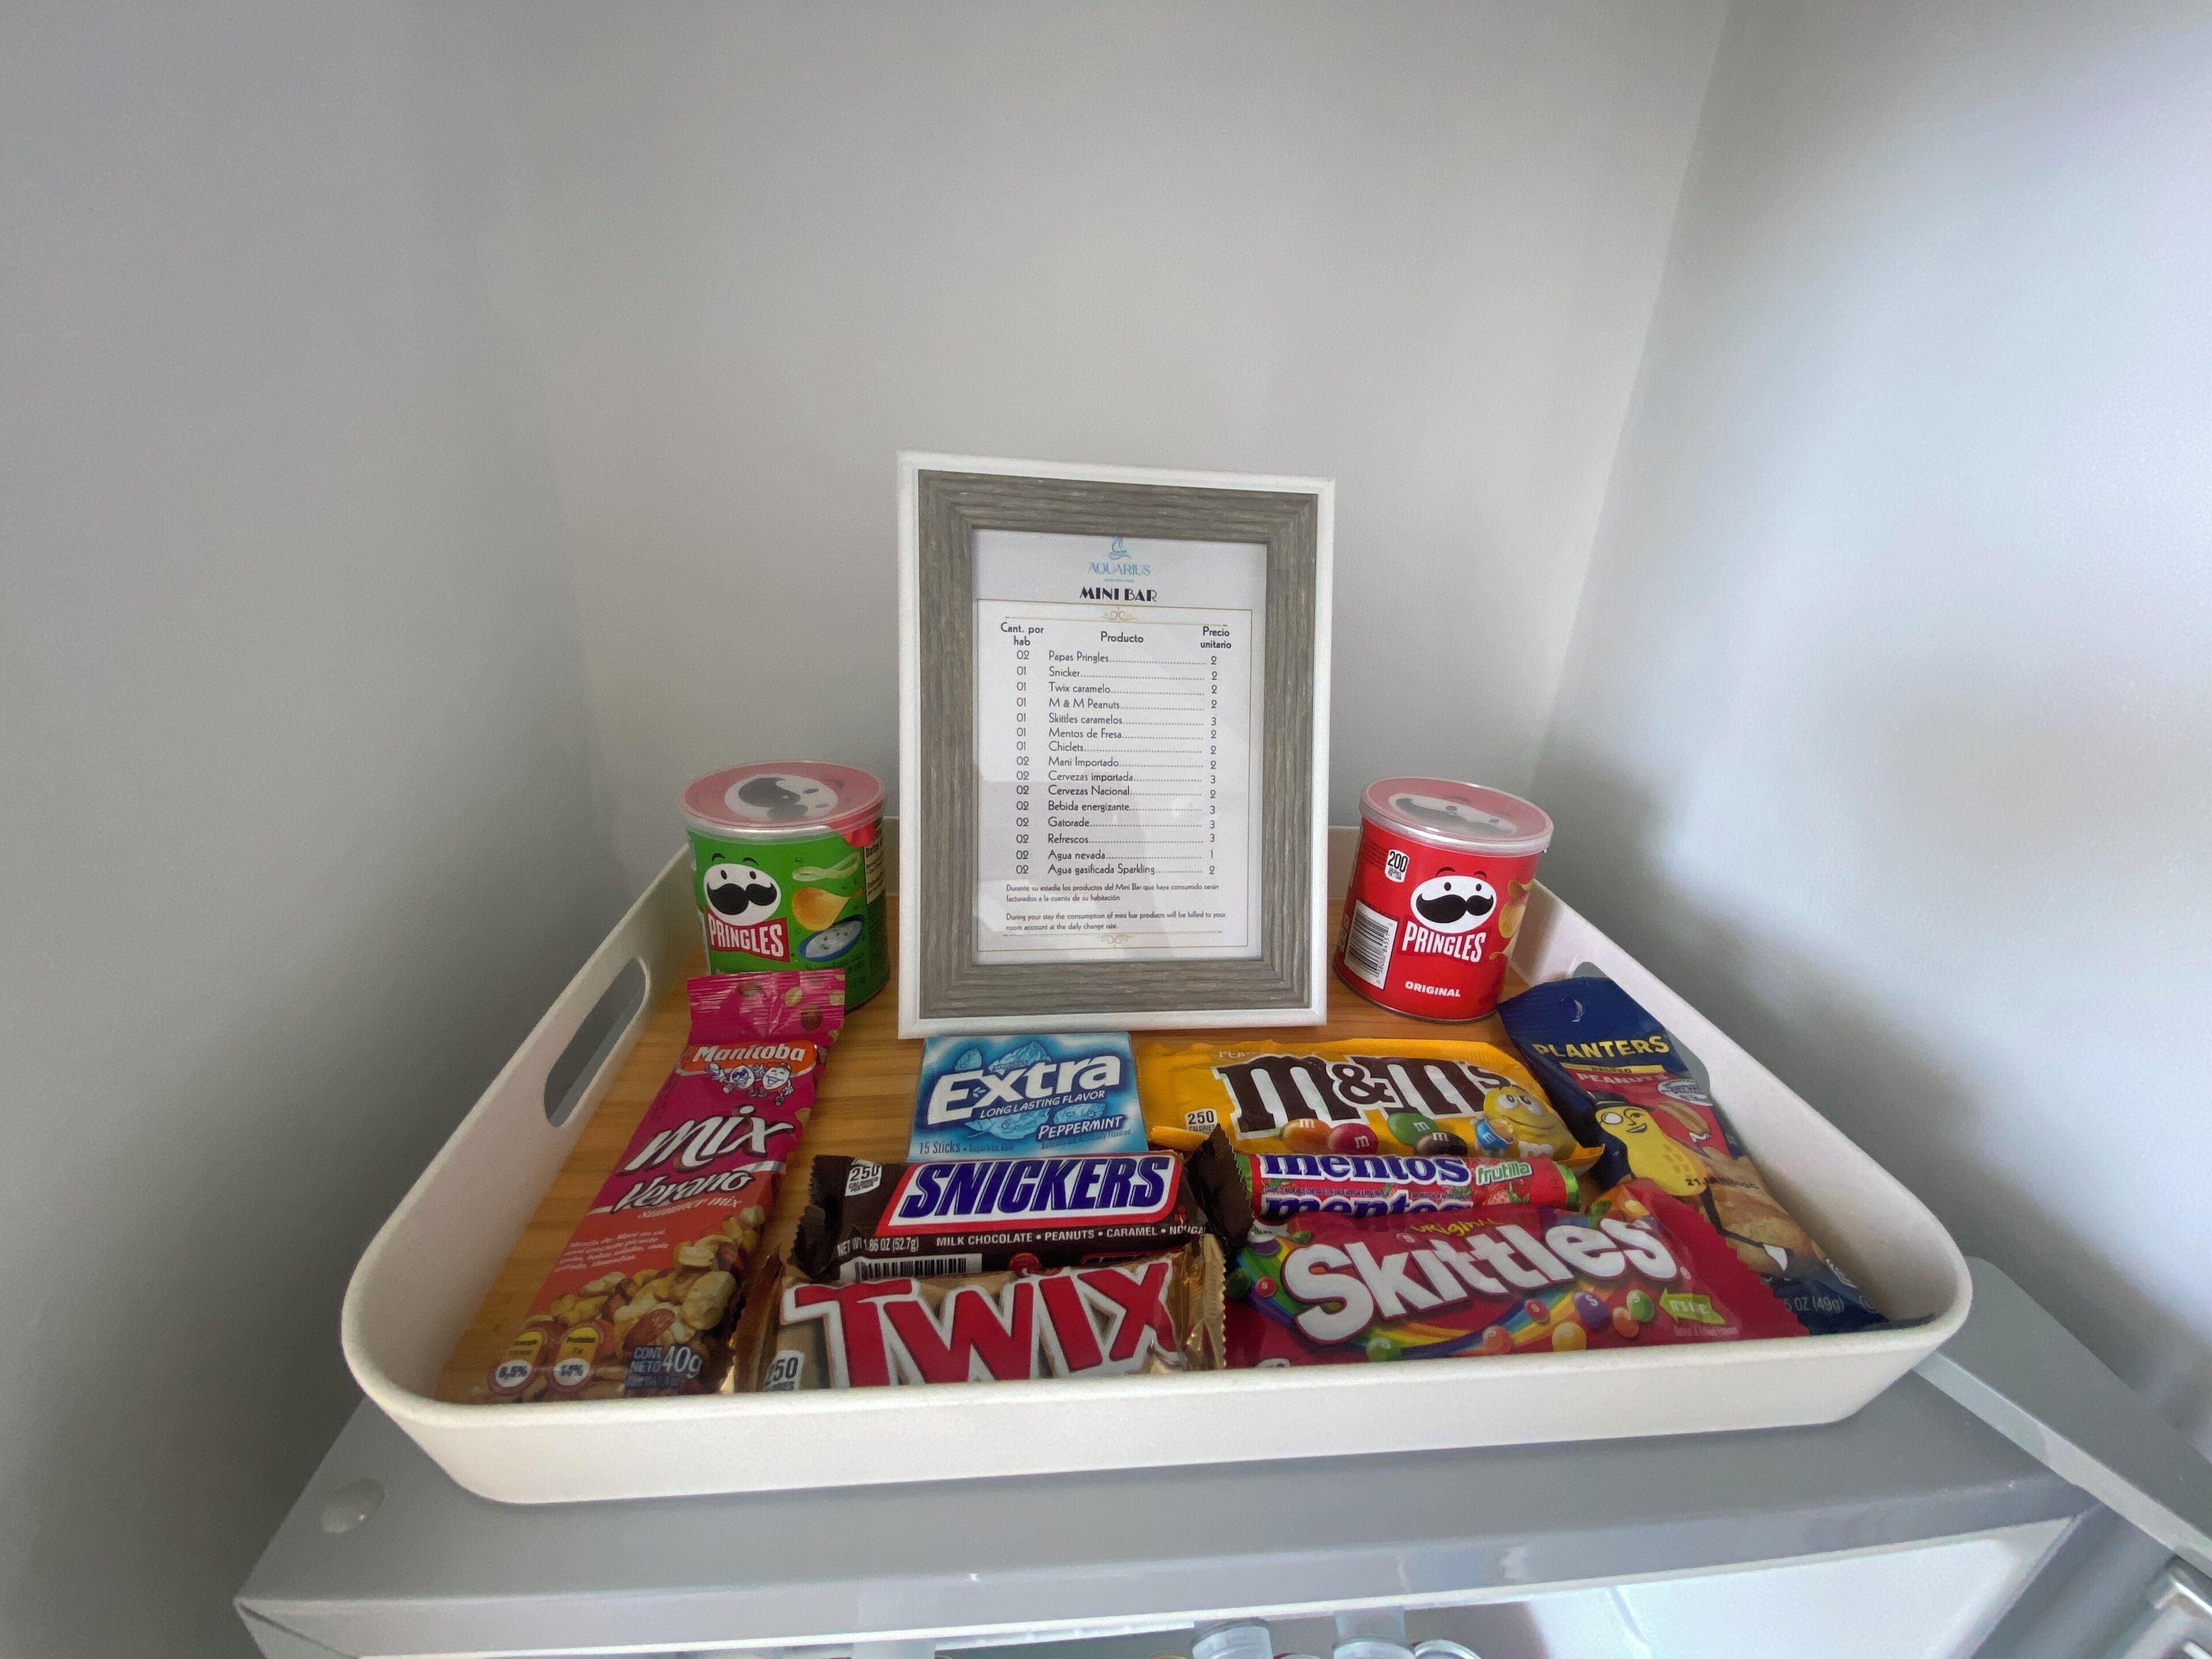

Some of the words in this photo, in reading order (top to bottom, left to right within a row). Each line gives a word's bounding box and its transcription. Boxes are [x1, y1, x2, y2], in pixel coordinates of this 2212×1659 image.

[1087, 562, 1151, 576] AQUARIUS
[1080, 586, 1120, 600] MINI
[1124, 588, 1158, 603] BAR
[1001, 622, 1024, 634] Cant.
[1028, 625, 1044, 635] por
[1202, 626, 1230, 638] Precio
[1013, 636, 1031, 646] hab
[1101, 631, 1145, 643] Producto
[1200, 639, 1232, 650] unitario
[1016, 650, 1030, 661] 02
[1048, 650, 1074, 663] Papas
[1076, 652, 1110, 664] Pringles
[1210, 656, 1218, 666] 2
[1016, 666, 1027, 676] 01
[1048, 666, 1081, 678] Snicker
[1211, 671, 1218, 681] 2
[1016, 681, 1027, 692] 01
[1048, 681, 1070, 693] Twix
[1072, 683, 1111, 694] caramelo
[1211, 684, 1218, 695] 2
[1016, 697, 1027, 708] 01
[1048, 698, 1060, 709] M
[1063, 699, 1071, 708] &
[1073, 698, 1085, 709] M
[1088, 699, 1120, 710] Peanuts
[1211, 699, 1218, 710] 2
[1016, 713, 1027, 723] 01
[1048, 713, 1078, 725] Skittles
[1081, 714, 1123, 726] caramelos
[1211, 717, 1217, 727] 3
[1016, 728, 1027, 738] 01
[1048, 728, 1084, 738] Mentos
[1086, 728, 1099, 738] de
[1101, 729, 1123, 740] Fresa
[1210, 730, 1217, 740] 2
[1016, 741, 1027, 751] 01
[1048, 741, 1084, 752] Chiclets
[1210, 745, 1217, 755] 2
[1016, 756, 1030, 766] 02
[1075, 756, 1120, 768] Importado
[1210, 760, 1217, 770] 2
[1016, 771, 1029, 781] 02
[1048, 770, 1089, 782] Cervezas
[1091, 772, 1134, 783] importada
[1210, 775, 1216, 785] 3
[1016, 785, 1029, 795] 02
[1048, 785, 1089, 796] Cervezas
[1091, 786, 1130, 796] Nacional
[1210, 790, 1216, 799] 2
[1016, 801, 1029, 811] 02
[1048, 801, 1079, 811] Bebida
[1081, 802, 1130, 813] energizante
[1210, 805, 1216, 815] 3
[1016, 817, 1029, 828] 02
[1048, 817, 1090, 828] Gatorade
[1210, 820, 1215, 830] 3
[1016, 834, 1029, 844] 02
[1048, 834, 1089, 844] Refrescos
[1210, 833, 1215, 843] 3
[1016, 850, 1029, 860] 02
[1047, 850, 1073, 862] Agua
[1075, 850, 1106, 861] nevada
[1210, 850, 1214, 859] 1
[1388, 851, 1408, 872] 200
[1016, 865, 1029, 875] 02
[1047, 864, 1073, 876] Agua
[1075, 863, 1115, 876] gasificada
[1118, 864, 1155, 876] Sparkling
[1209, 866, 1215, 875] 2
[1006, 884, 1030, 892] Durante
[1062, 884, 1071, 892] los
[1073, 884, 1103, 892] productos
[1104, 883, 1115, 891] del
[1116, 883, 1130, 891] Mini
[1156, 883, 1169, 893] haya
[1171, 883, 1203, 891] consumido
[1006, 894, 1037, 903] facturados
[1006, 912, 1026, 922] During
[1043, 913, 1054, 922] stay
[1055, 912, 1065, 920] the
[1067, 912, 1105, 921] consumption
[1107, 911, 1113, 920] of
[1115, 912, 1127, 920] mini
[1128, 911, 1138, 919] bar
[1139, 912, 1165, 921] products
[1166, 911, 1177, 919] will
[1178, 911, 1186, 919] be
[1187, 911, 1204, 919] billed
[1213, 912, 1226, 920] your
[1067, 922, 1082, 931] daily
[1083, 923, 1104, 931] change
[707, 912, 784, 957] PRINGLES
[1402, 921, 1486, 963] PRINGLES
[1404, 980, 1461, 998] ORIGINAL
[692, 1043, 806, 1062] Manitoba
[1531, 1035, 1671, 1060] PLANTERS
[1577, 1073, 1669, 1085] PEANUTS
[926, 1055, 1121, 1126] Extra
[980, 1104, 1012, 1119] LONG
[1013, 1096, 1060, 1114] LASTING
[1062, 1089, 1106, 1105] FLAVOR
[1187, 1110, 1214, 1125] 250
[1037, 1115, 1124, 1140] PEPPERMINT
[919, 1142, 930, 1154] 15
[932, 1140, 961, 1153] Sticks
[850, 1164, 880, 1182] 250
[1262, 1154, 1471, 1184] mentos
[1475, 1161, 1533, 1185] frutilla
[612, 1169, 754, 1213] Verano
[898, 1154, 1172, 1218] SNICKERS
[936, 1234, 965, 1247] MILK
[968, 1231, 1033, 1245] CHOCOLATE
[1044, 1229, 1096, 1242] PEANUTS
[1105, 1225, 1158, 1238] CARAMEL
[1169, 1225, 1207, 1236] NOUGA
[837, 1240, 851, 1257] NET
[880, 1237, 891, 1251] OZ
[1282, 1217, 1679, 1346] Skittles
[1795, 1298, 1810, 1312] OZ
[794, 1260, 1180, 1387] TWIX
[631, 1360, 662, 1373] NETO
[662, 1346, 702, 1379] 40g
